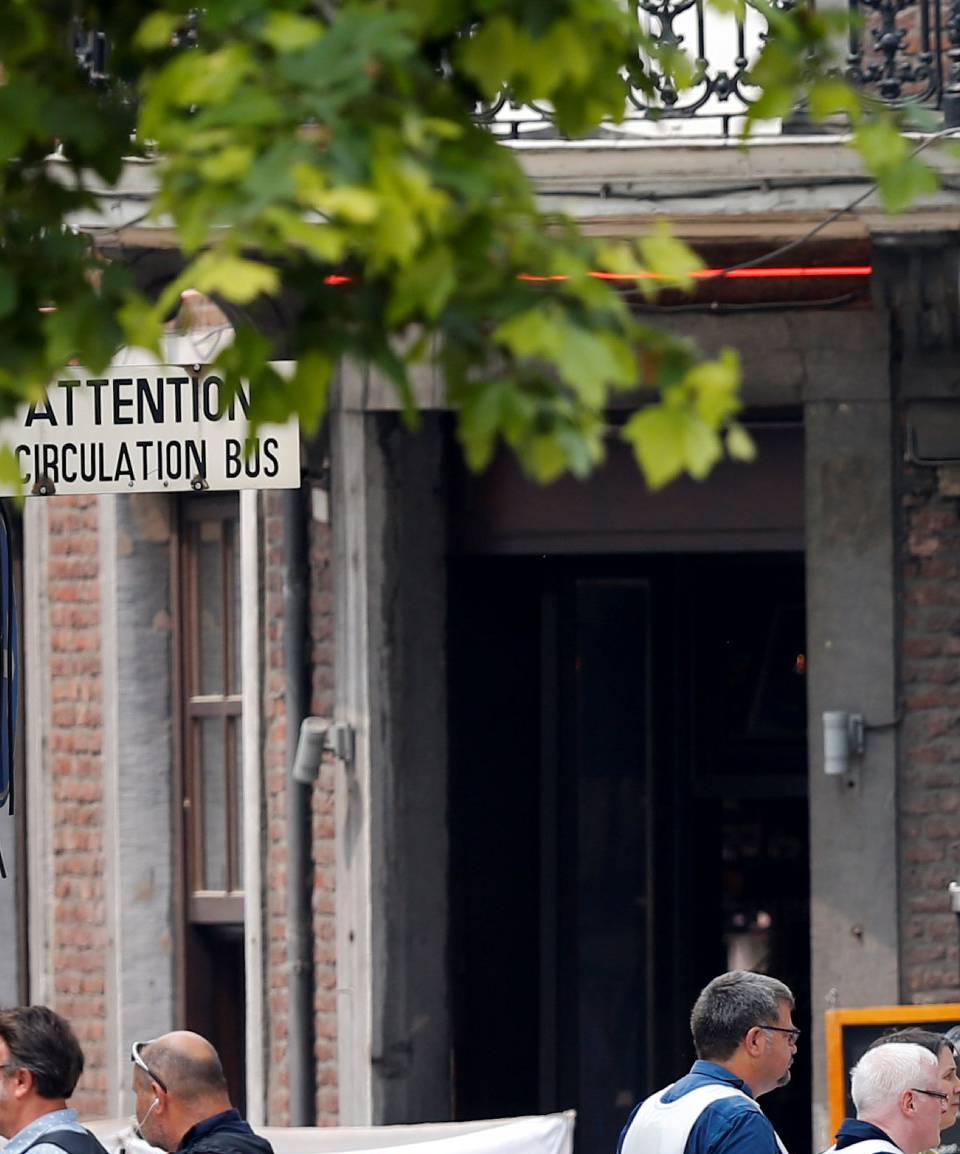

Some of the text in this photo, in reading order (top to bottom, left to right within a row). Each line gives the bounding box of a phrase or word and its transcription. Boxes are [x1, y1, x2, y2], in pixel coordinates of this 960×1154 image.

[25, 375, 251, 427] ATTENTION
[15, 438, 279, 484] CIRCULATION BUS
